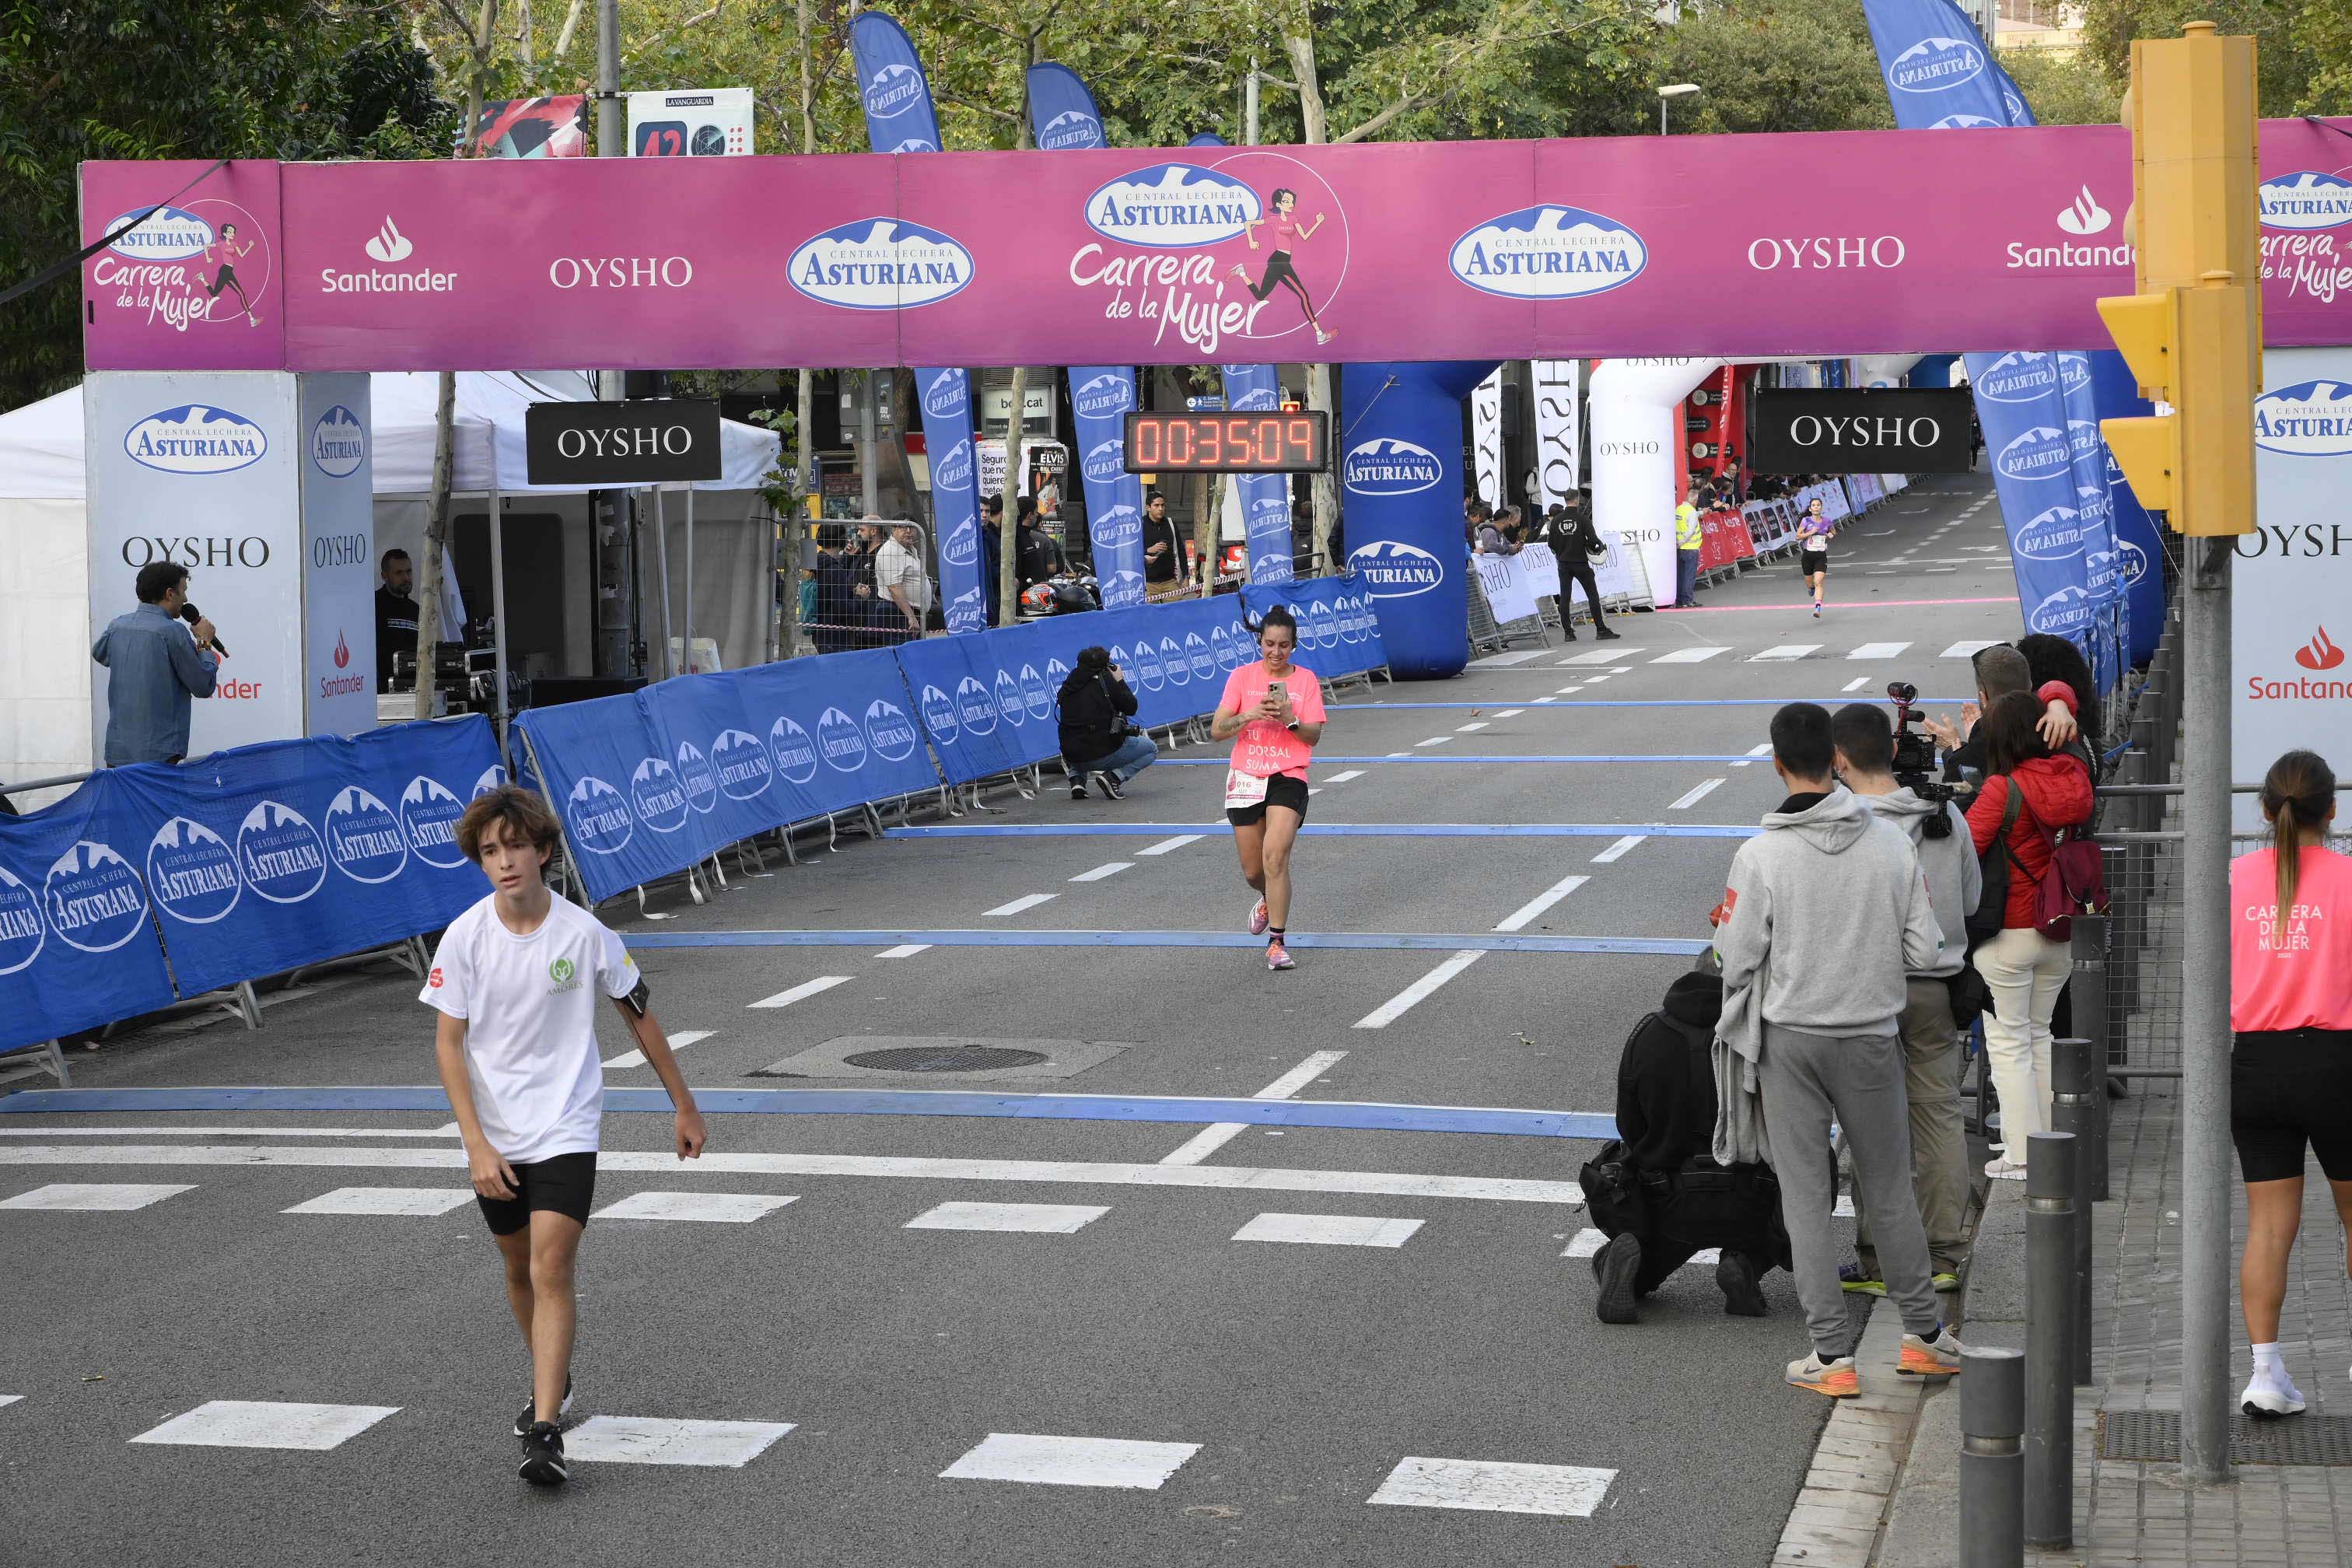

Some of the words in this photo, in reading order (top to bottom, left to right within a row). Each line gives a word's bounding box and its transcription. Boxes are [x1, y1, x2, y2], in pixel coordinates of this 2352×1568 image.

[1125, 192, 1181, 201] CENTRAL
[1186, 191, 1244, 201] LECHERA
[1098, 195, 1248, 226] ASTURIANA
[829, 249, 889, 259] CENTRAL
[1495, 237, 1556, 247] CENTRAL
[1563, 236, 1626, 246] LECHERA
[1748, 236, 1906, 271] OYSHO
[2259, 234, 2334, 257] arrera
[1069, 243, 1216, 286] Carrera
[1465, 240, 1632, 275] ASTURIANA
[2007, 242, 2135, 268] Santand
[94, 257, 184, 286] Carrera
[322, 268, 457, 292] Santander
[549, 256, 693, 289] OYSHO
[801, 253, 960, 285] ASTURIANA
[2278, 257, 2292, 278] la
[2288, 253, 2352, 303] Muje
[116, 288, 134, 308] de
[138, 288, 149, 308] la
[148, 285, 220, 332] Mujer
[1106, 289, 1131, 319] de
[1138, 287, 1157, 319] la
[1154, 281, 1269, 354] Mujer
[135, 431, 257, 457] ASTURIANA
[558, 425, 692, 458] OYSHO
[1790, 415, 1940, 447] OYSHO
[317, 432, 362, 459] ASTURIANA
[1041, 453, 1064, 464] ELVIS
[1601, 441, 1659, 457] OYSHO
[983, 477, 1006, 485] quiere
[1346, 462, 1435, 483] ASTURIANA
[122, 537, 270, 568] OYSHO
[314, 534, 366, 569] OYSHO
[1352, 564, 1435, 583] TURIANA
[320, 674, 364, 699] Santander
[2249, 676, 2352, 700] Santan
[1248, 744, 1291, 758] DORSAL
[1246, 759, 1280, 770] SUMA
[333, 825, 404, 863] ASTURIANA
[245, 844, 323, 882] ASTURIANA
[156, 862, 237, 902] ASTURIANA
[2245, 905, 2323, 921] CARERA
[2287, 919, 2307, 934] LA
[2259, 935, 2310, 951] MUJER
